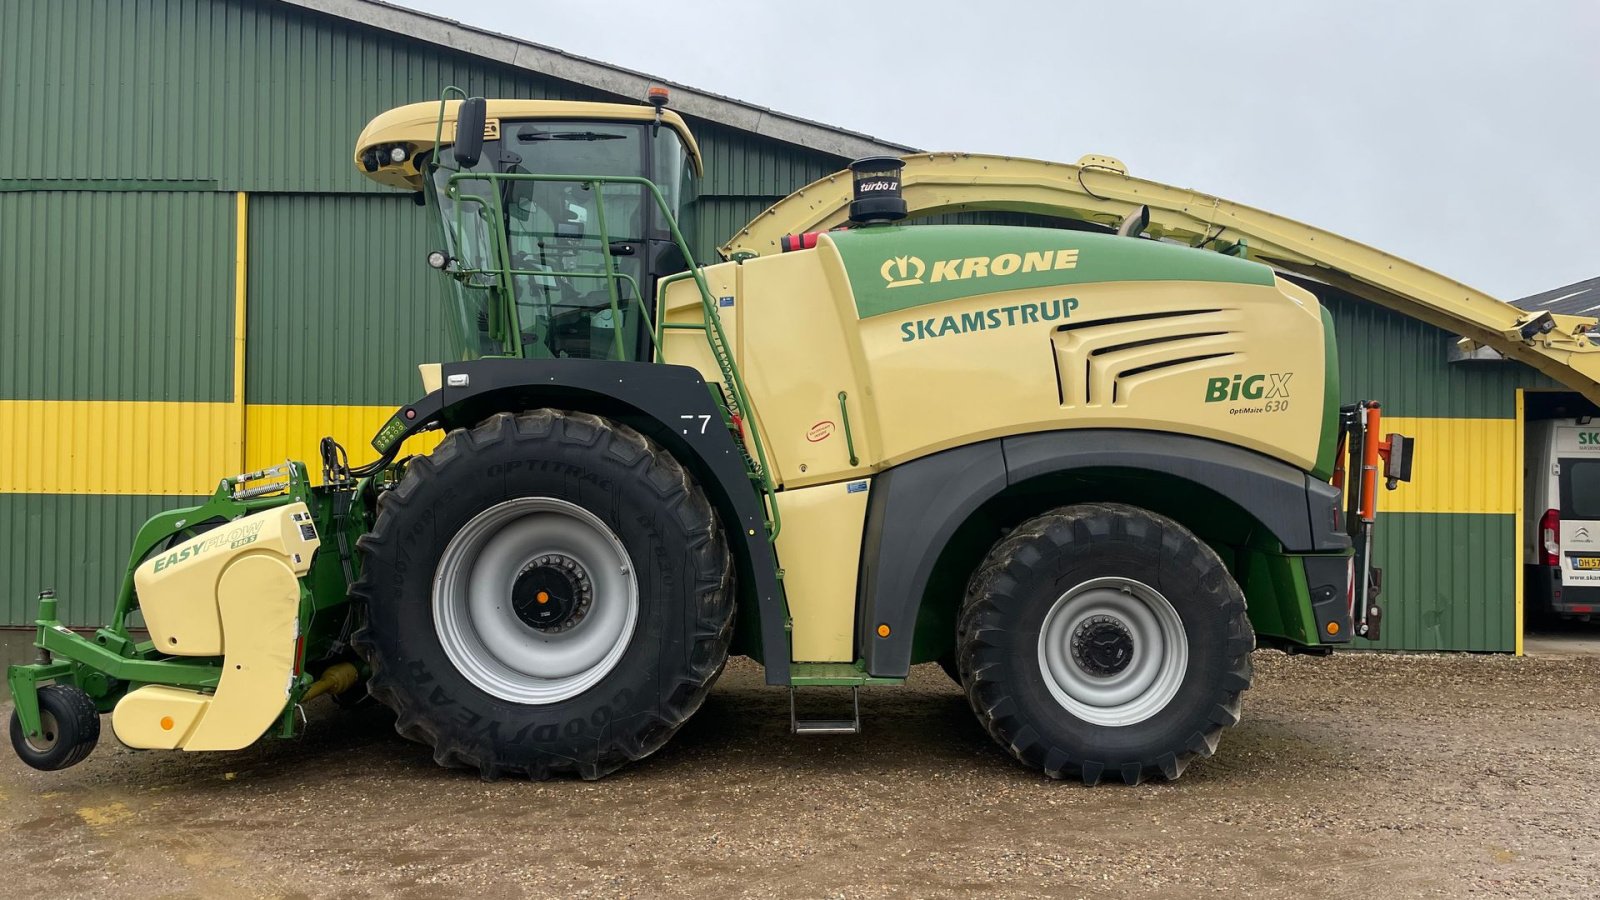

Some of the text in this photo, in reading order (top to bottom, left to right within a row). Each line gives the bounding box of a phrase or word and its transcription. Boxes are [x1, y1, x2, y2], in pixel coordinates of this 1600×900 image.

[860, 181, 889, 192] turbo
[930, 249, 1080, 283] KRONE
[900, 297, 1079, 342] SKAMSTRUP
[1229, 400, 1289, 415] OptiMaize 630
[1579, 557, 1590, 567] DH
[407, 657, 635, 746] GOODYEAR
